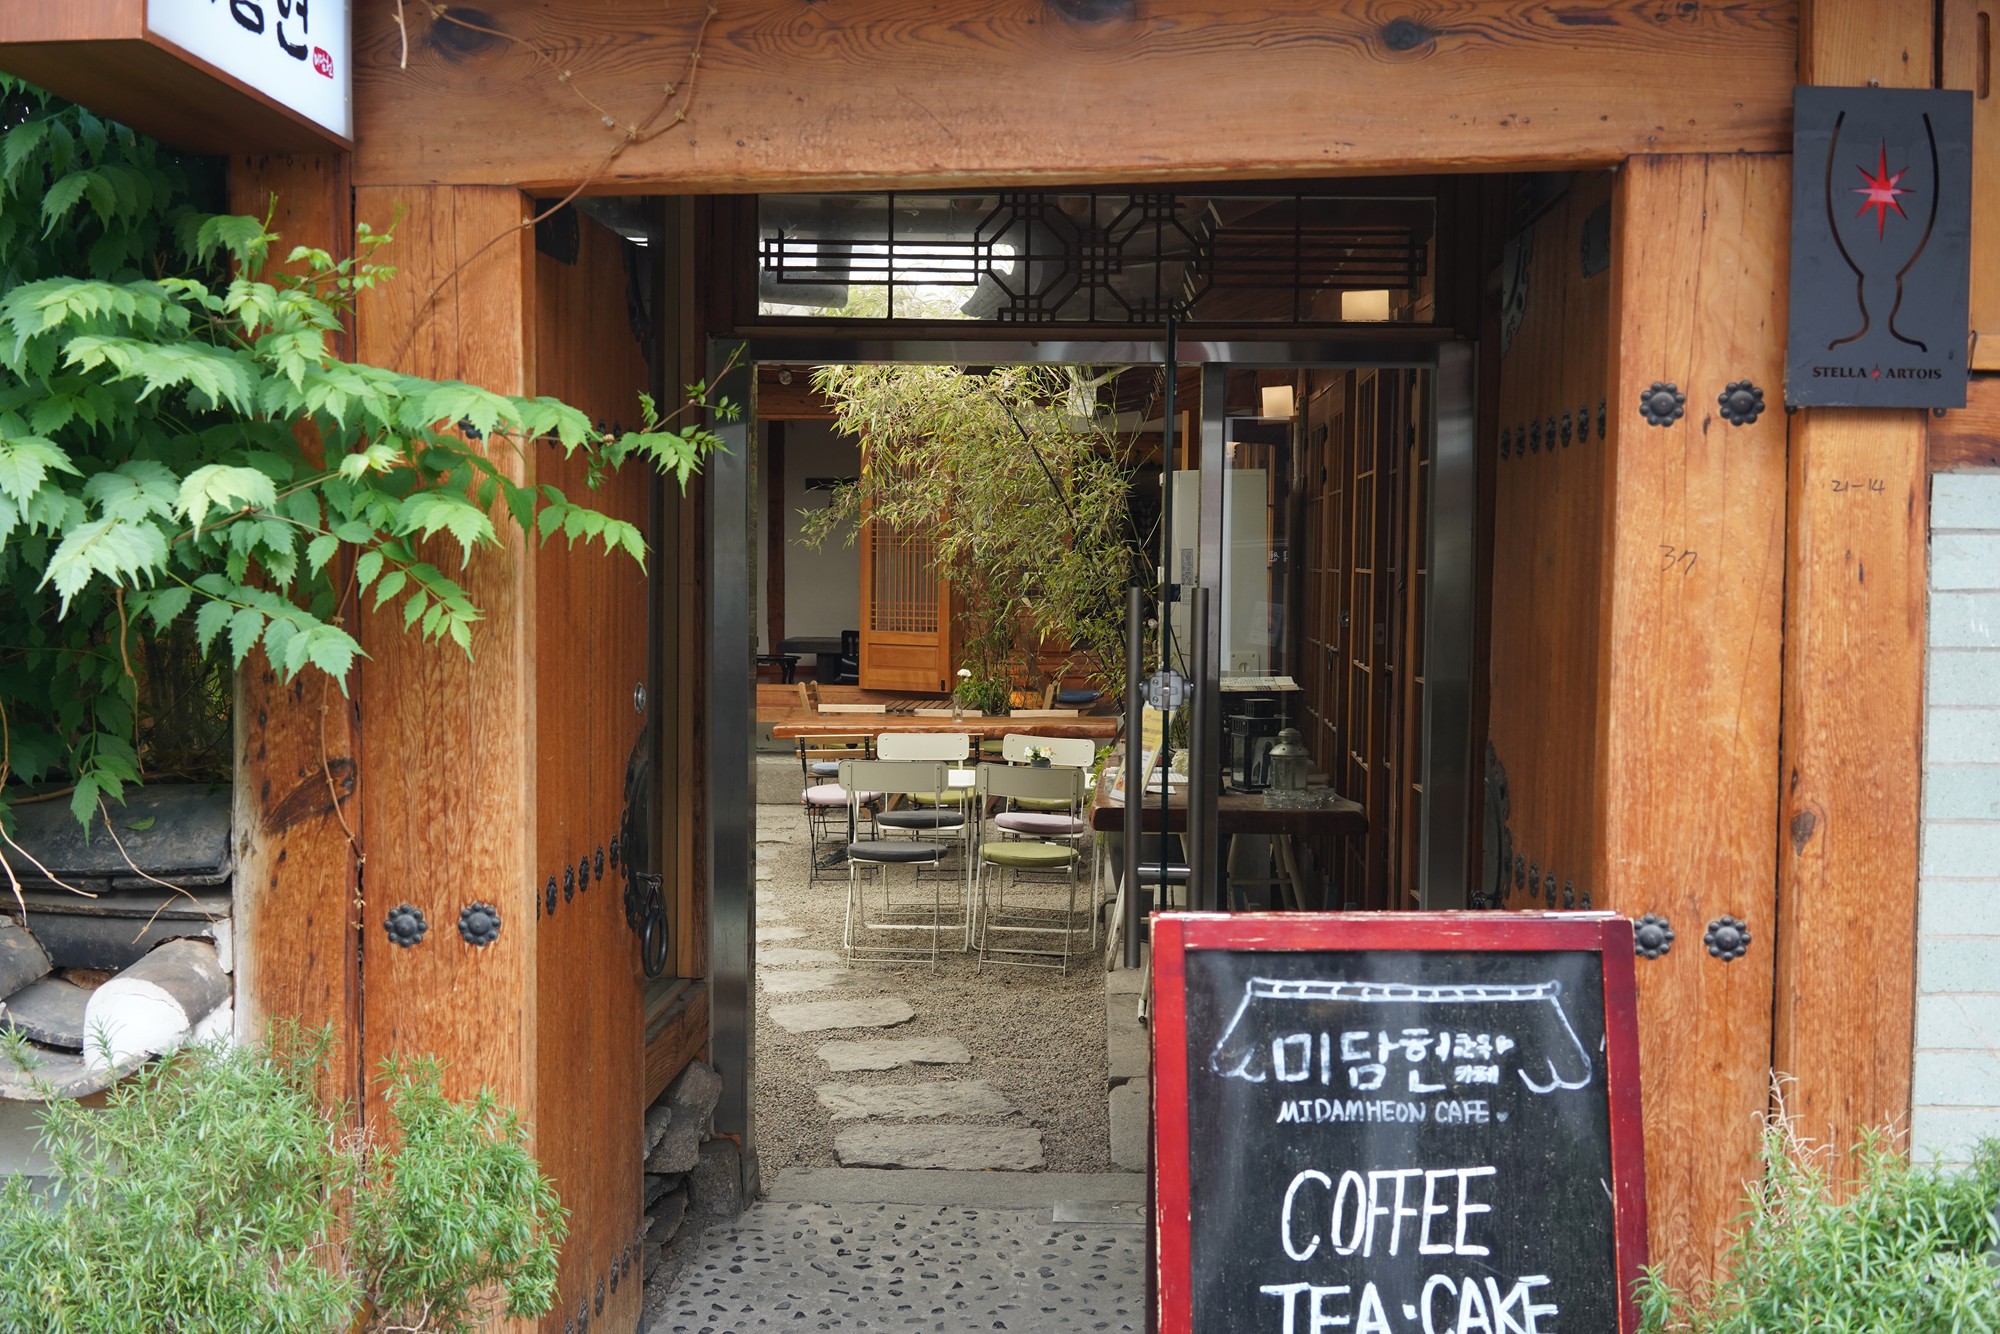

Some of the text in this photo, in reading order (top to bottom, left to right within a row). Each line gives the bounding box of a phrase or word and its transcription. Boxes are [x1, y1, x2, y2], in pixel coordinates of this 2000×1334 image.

[1812, 366, 1942, 380] STELLA ARTOIS
[1272, 1028, 1450, 1093] 미담헌
[1276, 1099, 1490, 1124] MIDAMHEON CAFE
[1281, 1166, 1497, 1261] COFFEE
